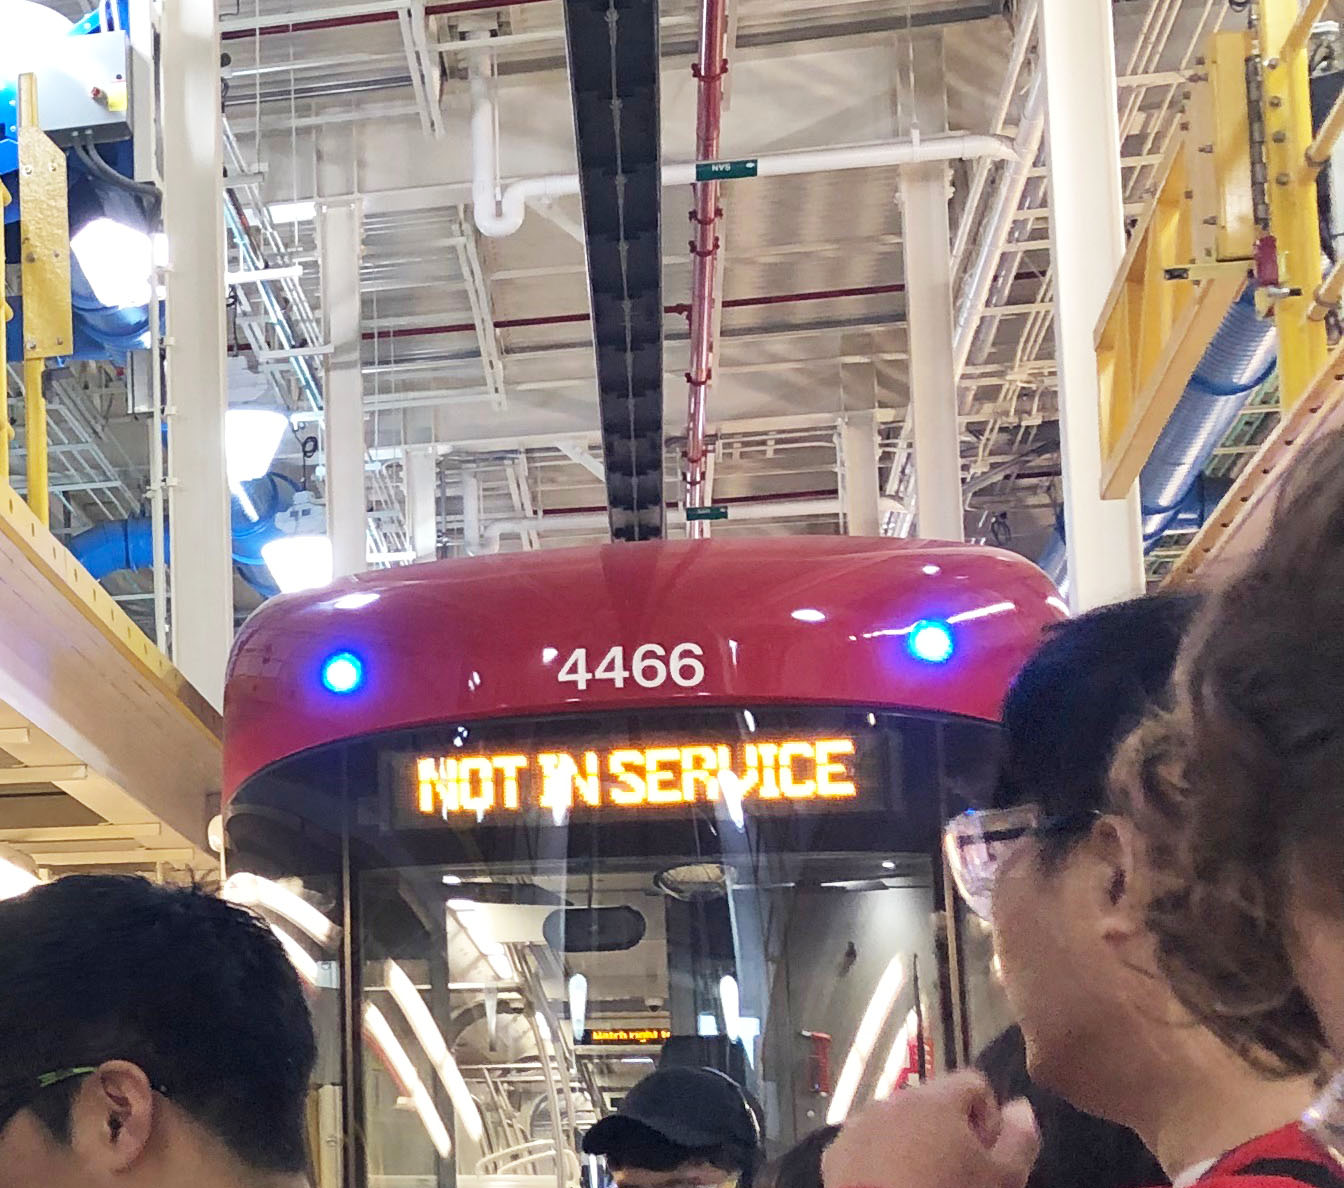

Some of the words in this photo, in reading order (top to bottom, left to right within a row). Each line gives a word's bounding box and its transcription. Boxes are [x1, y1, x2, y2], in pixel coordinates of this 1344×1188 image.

[558, 642, 705, 690] 4466
[416, 754, 528, 814] NOT
[537, 750, 600, 808] IN
[608, 737, 857, 804] SERVICE
